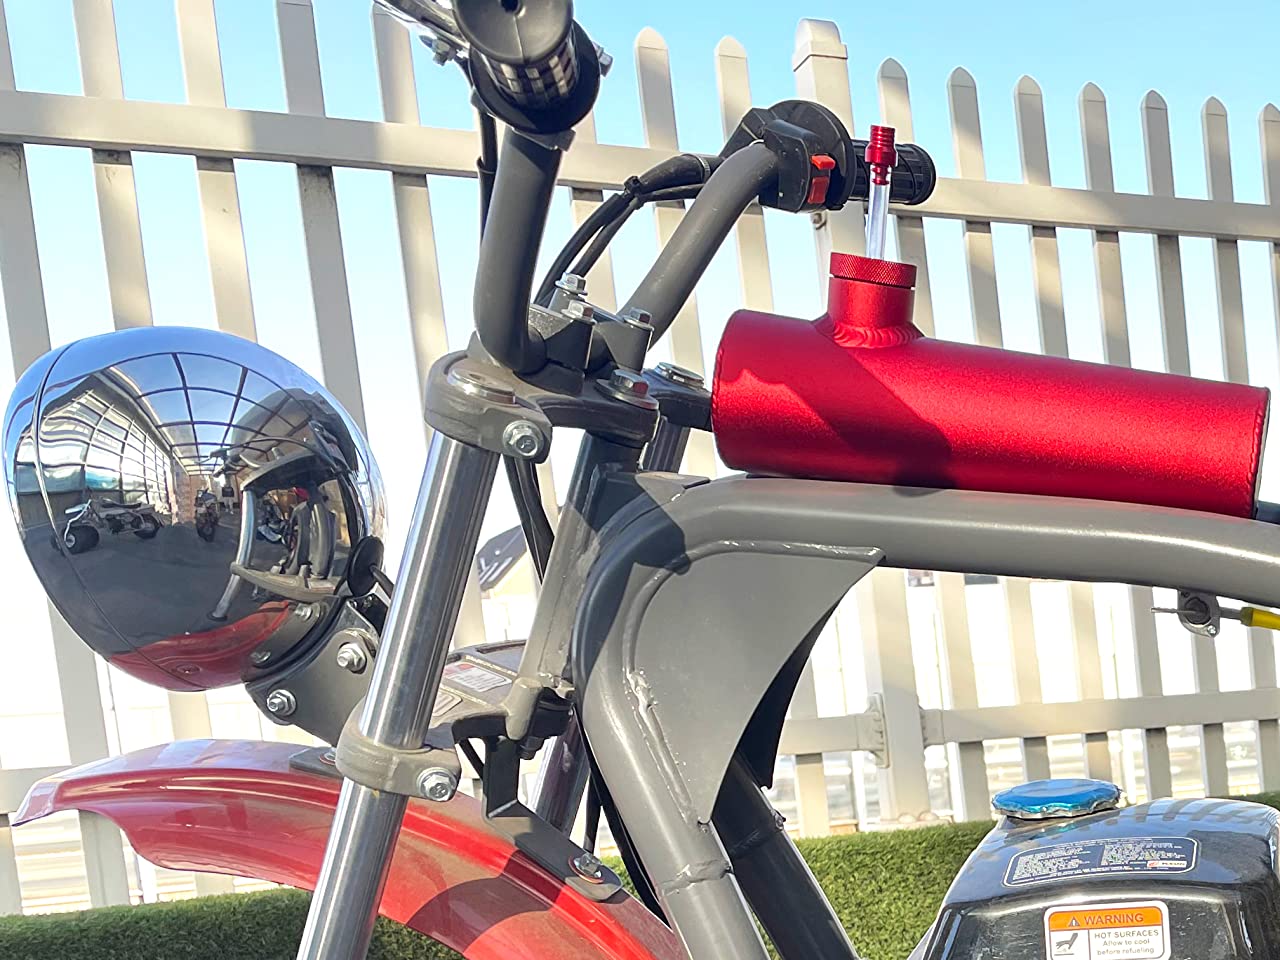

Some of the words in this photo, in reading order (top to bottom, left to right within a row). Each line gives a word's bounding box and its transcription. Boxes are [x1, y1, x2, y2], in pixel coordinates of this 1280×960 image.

[1084, 912, 1144, 925] WARNING
[1094, 931, 1112, 940] HOT
[1114, 929, 1159, 939] SURFACES
[1134, 938, 1150, 946] cool
